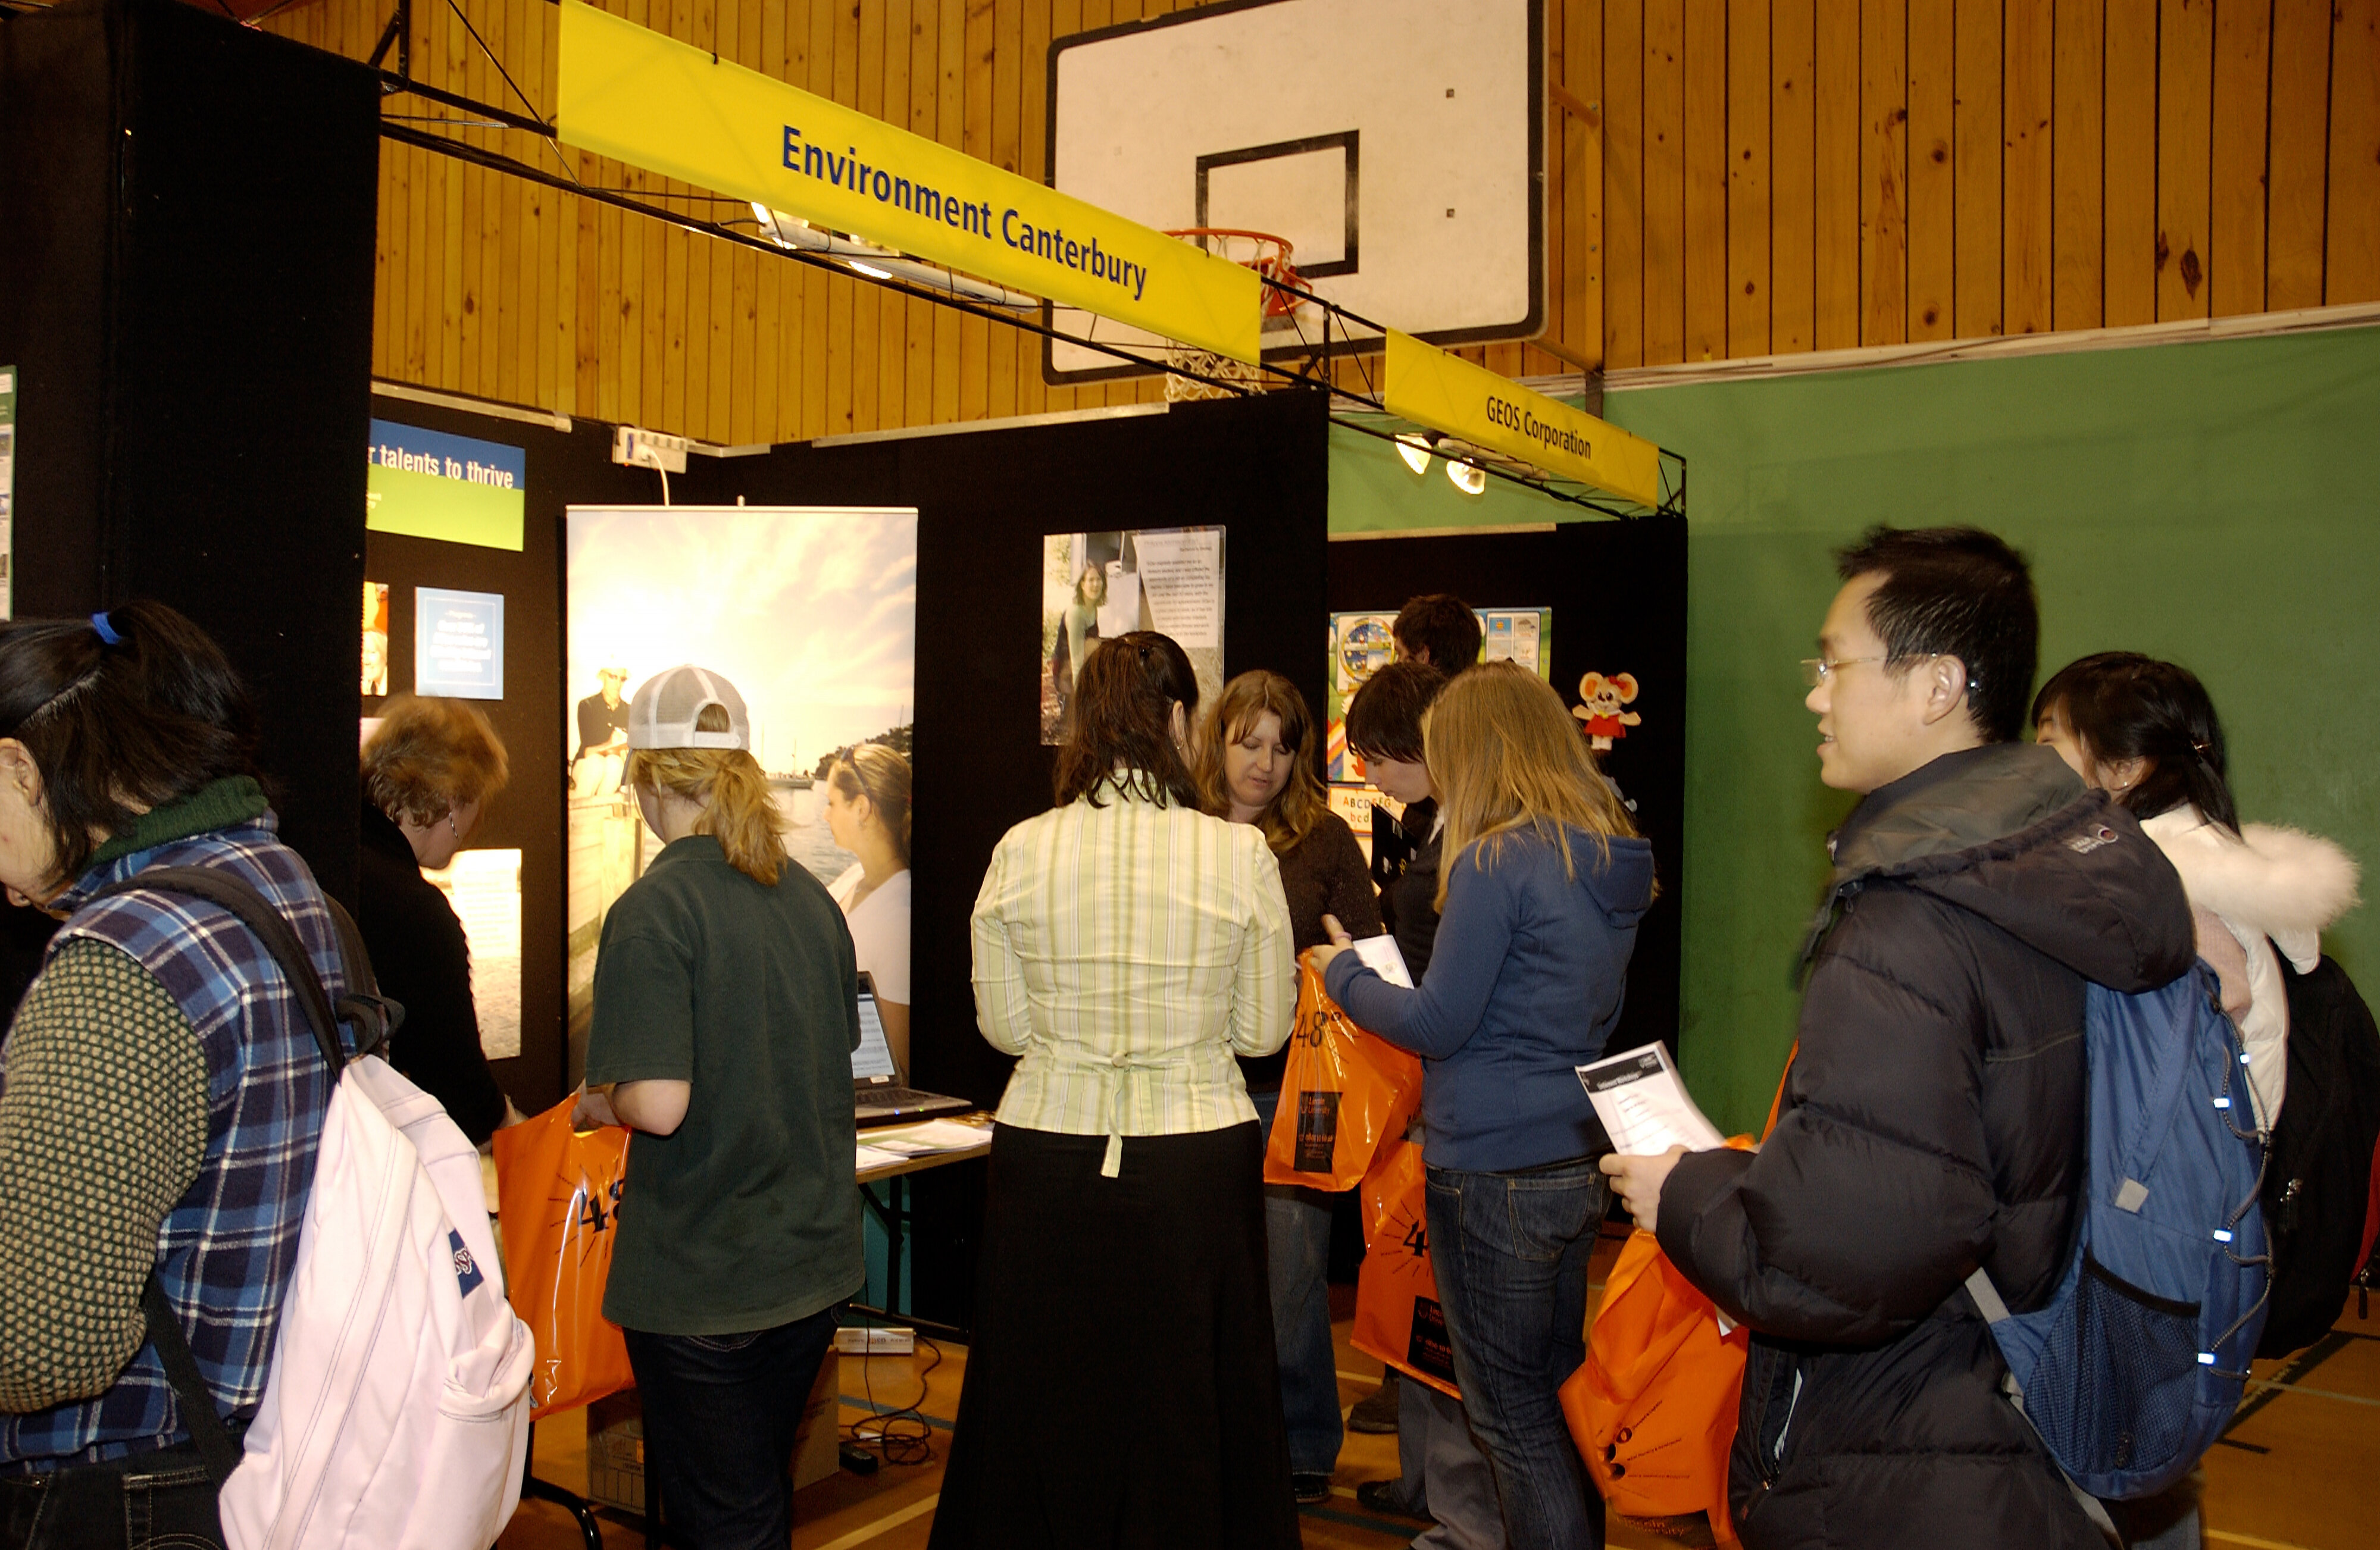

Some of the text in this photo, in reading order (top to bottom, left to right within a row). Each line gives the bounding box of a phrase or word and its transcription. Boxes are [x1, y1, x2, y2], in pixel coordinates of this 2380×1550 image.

[783, 124, 1146, 301] Environment Canterbury
[1487, 396, 1591, 460] GEOS Corporation
[380, 444, 439, 477] talents
[445, 456, 462, 481] to
[467, 460, 514, 490] thrive
